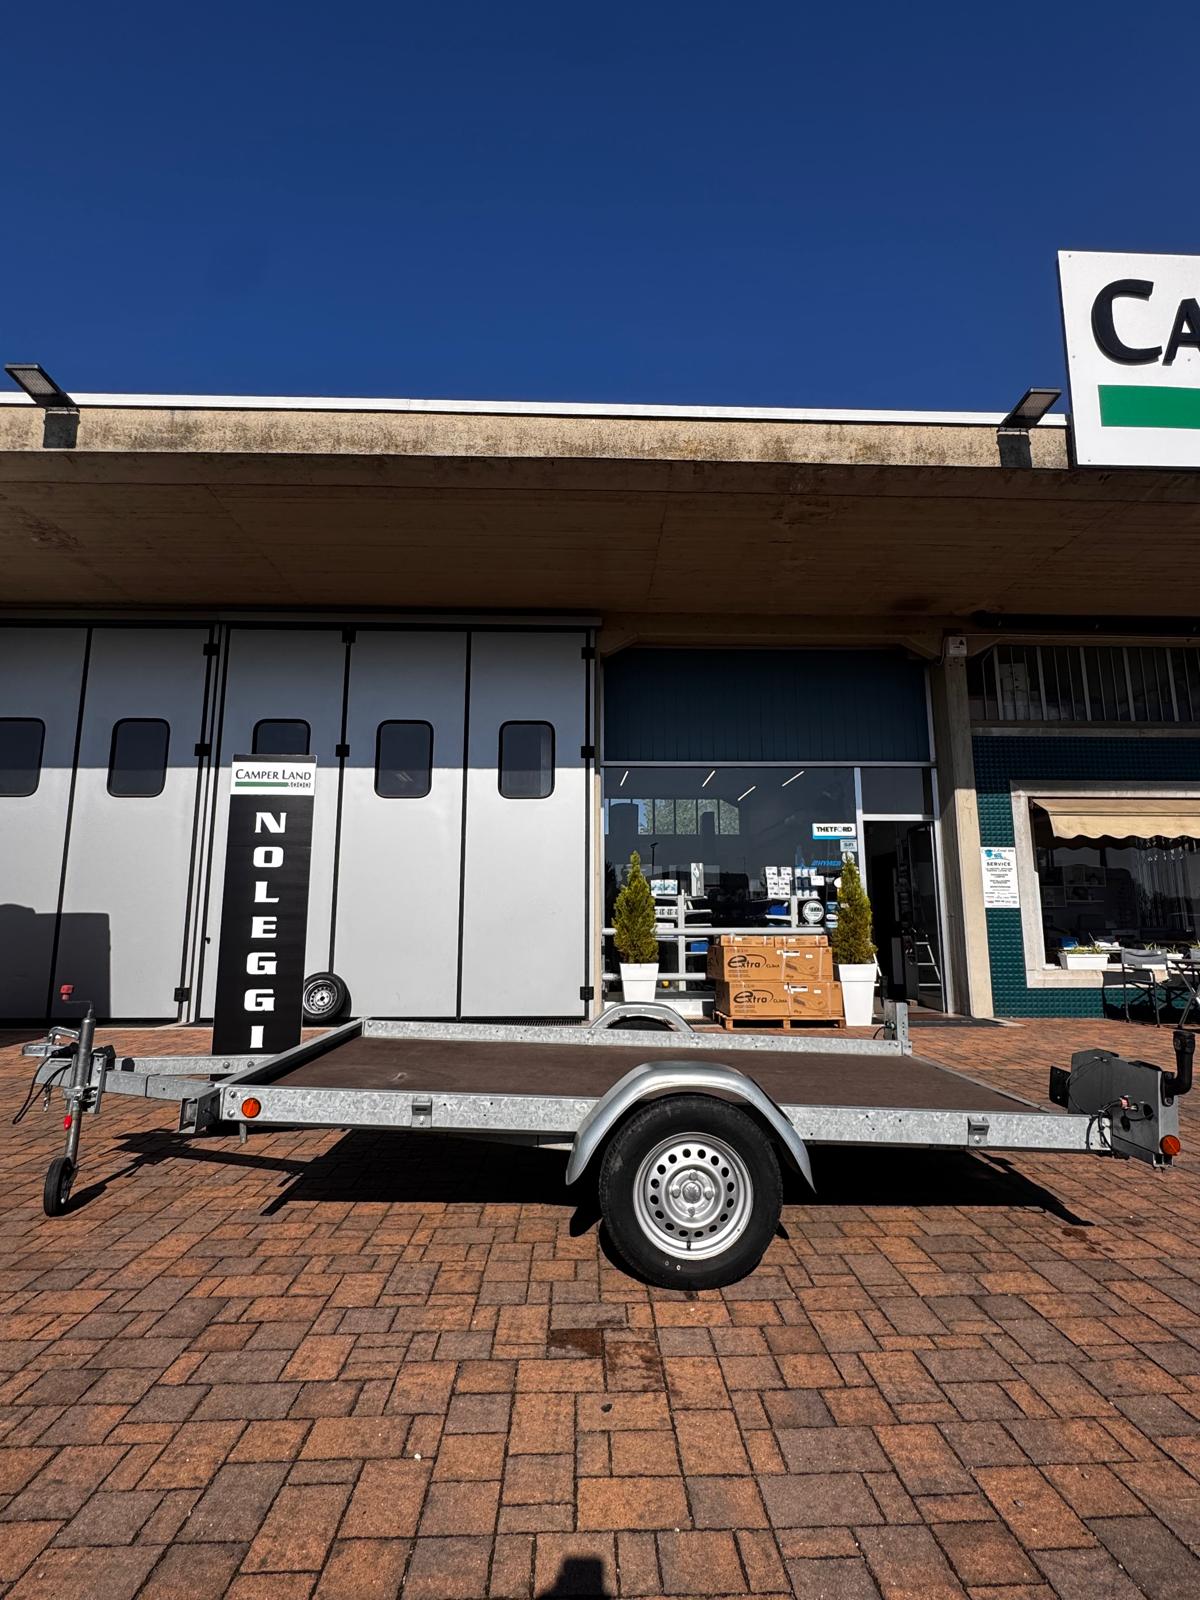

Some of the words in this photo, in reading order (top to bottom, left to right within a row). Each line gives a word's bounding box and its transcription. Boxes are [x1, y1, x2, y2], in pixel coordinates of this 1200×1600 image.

[235, 768, 279, 780] CAMPER
[282, 769, 312, 781] LAND
[243, 812, 288, 1049] NOLEGGI
